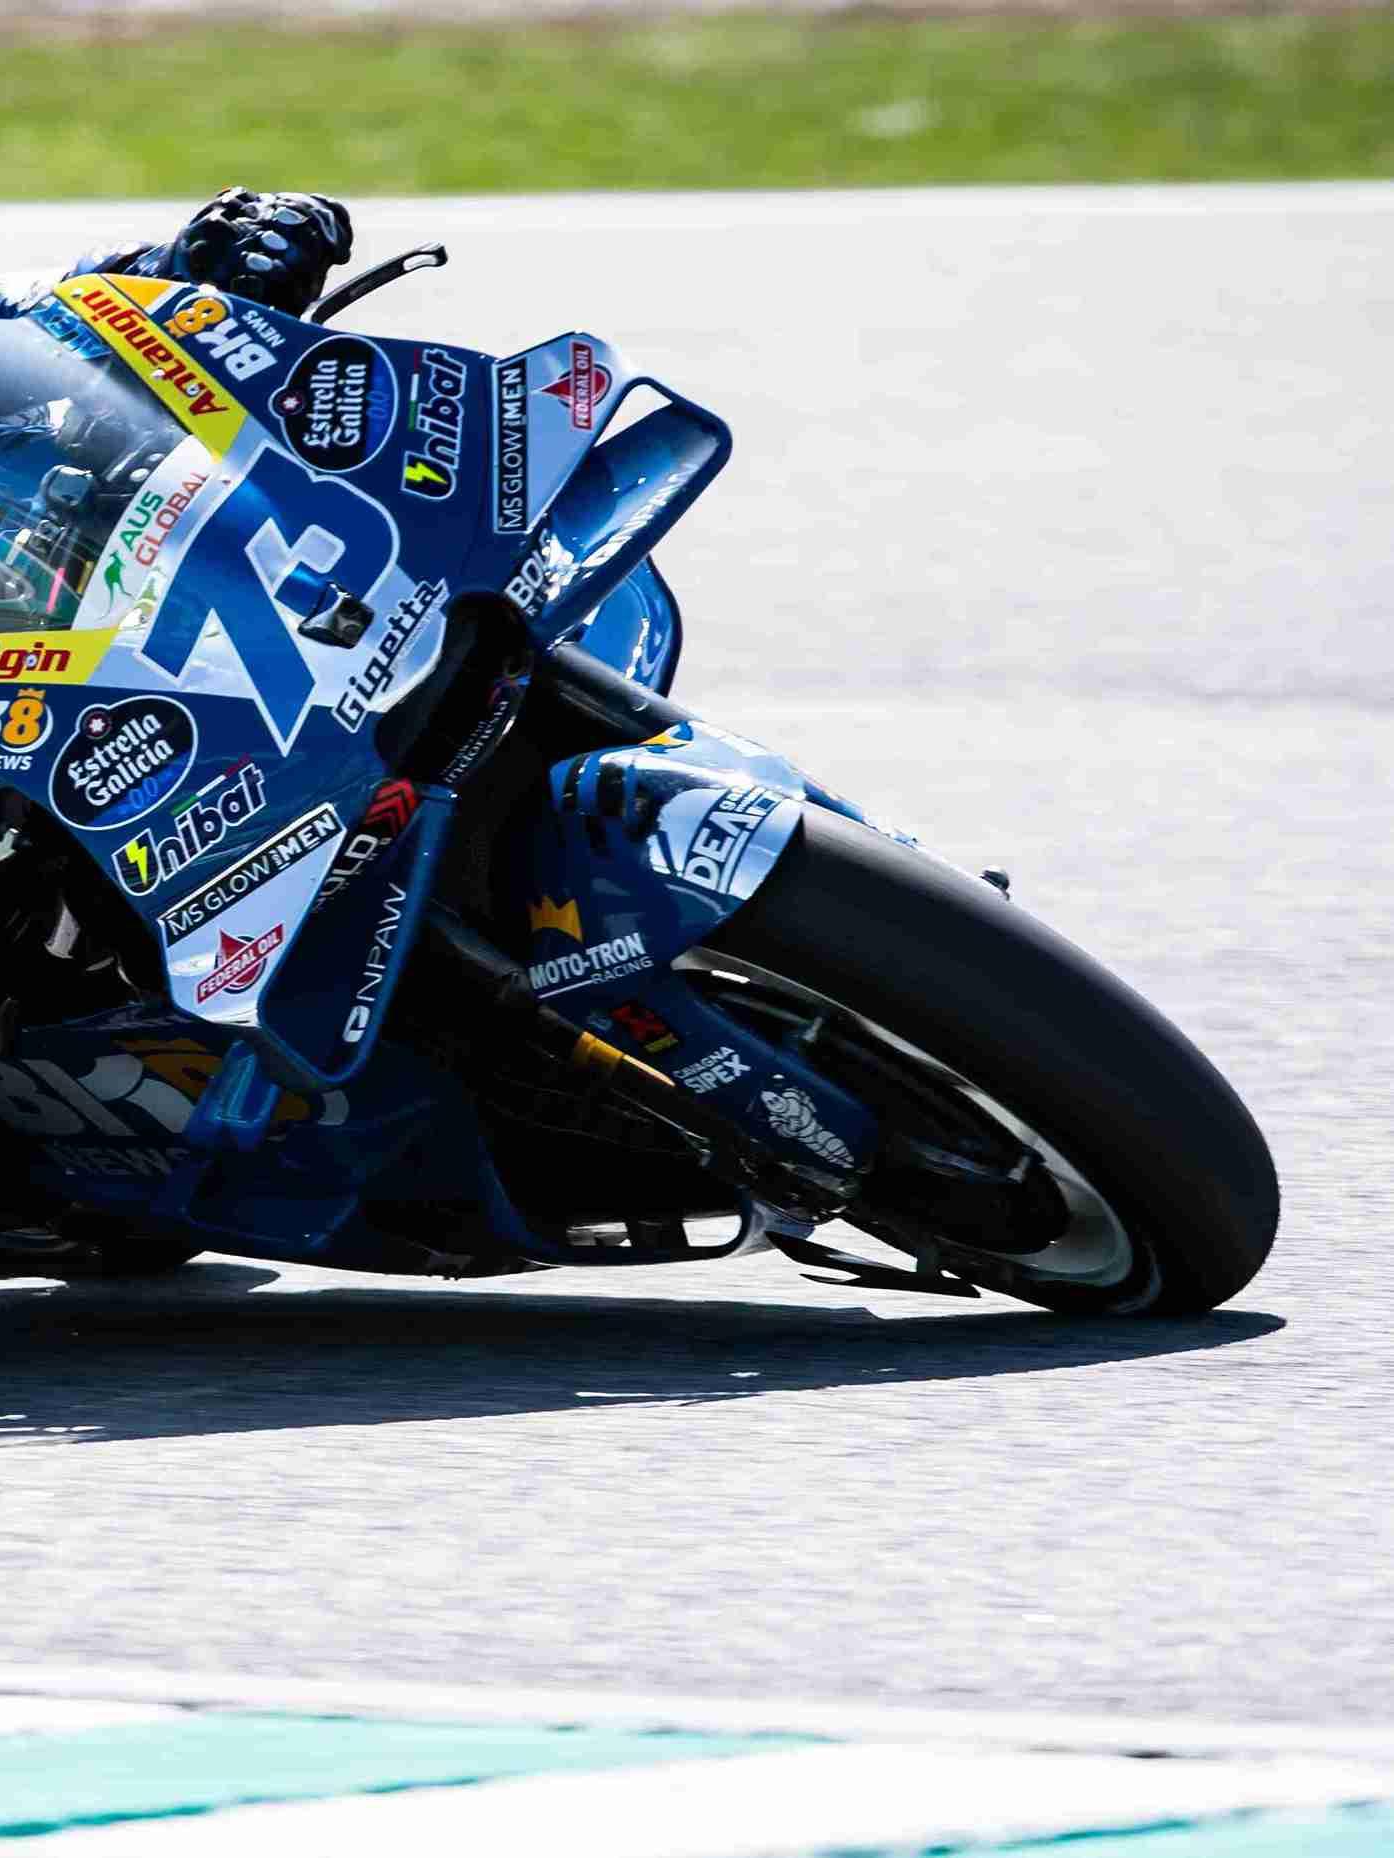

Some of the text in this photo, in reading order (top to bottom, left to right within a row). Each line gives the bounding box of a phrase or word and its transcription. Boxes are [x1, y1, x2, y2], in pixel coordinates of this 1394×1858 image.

[81, 288, 230, 417] Antangin
[173, 296, 278, 382] BK8
[240, 310, 286, 348] NEWS
[303, 359, 339, 448] Estrella
[332, 363, 367, 446] Galicia
[401, 349, 467, 500] Unibat
[502, 367, 524, 420] MEN
[574, 347, 590, 429] FEDERAL OIL
[502, 429, 523, 492] GLOW
[120, 491, 165, 552] AUS
[135, 472, 208, 567] GLOBAL
[501, 497, 524, 528] MS
[136, 438, 402, 758] 73
[332, 578, 451, 733] Gigetta
[68, 714, 162, 790] Estrella
[85, 737, 174, 807] Galicia
[111, 763, 265, 896] Unibat
[170, 906, 204, 936] MS
[205, 855, 270, 912] GLOW
[279, 814, 338, 863] MEN
[198, 928, 280, 1000] FEDERAL OIL
[530, 933, 647, 991] MOTO-TRON
[591, 955, 654, 985] RACING
[684, 1053, 752, 1094] SIPEX
